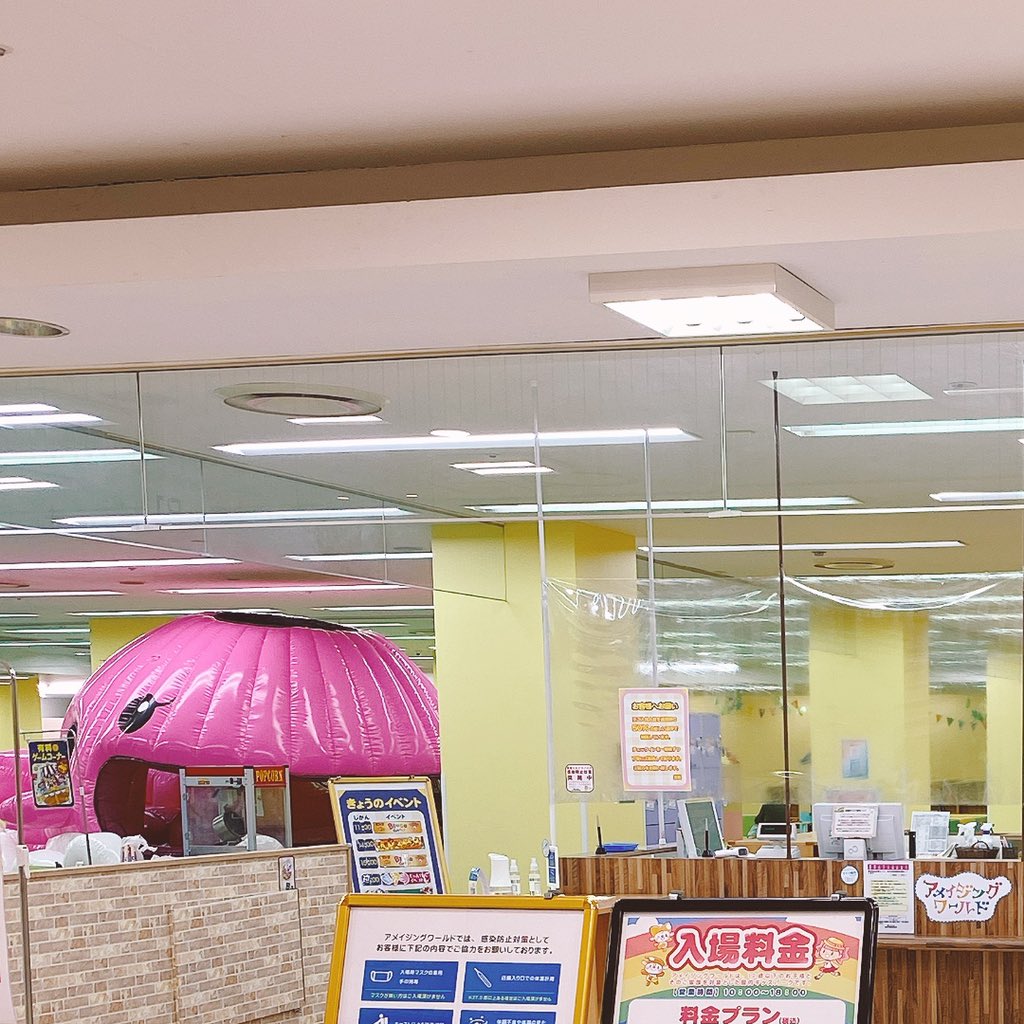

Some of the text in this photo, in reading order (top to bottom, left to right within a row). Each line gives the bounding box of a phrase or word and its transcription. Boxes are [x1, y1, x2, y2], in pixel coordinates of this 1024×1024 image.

[346, 797, 421, 810] きょうのイベント
[924, 879, 1002, 900] アメイジング
[933, 899, 990, 916] ワールド
[376, 944, 553, 955] お客様に下記の内容でご協力をお願いしております。
[672, 931, 810, 964] 入場料金
